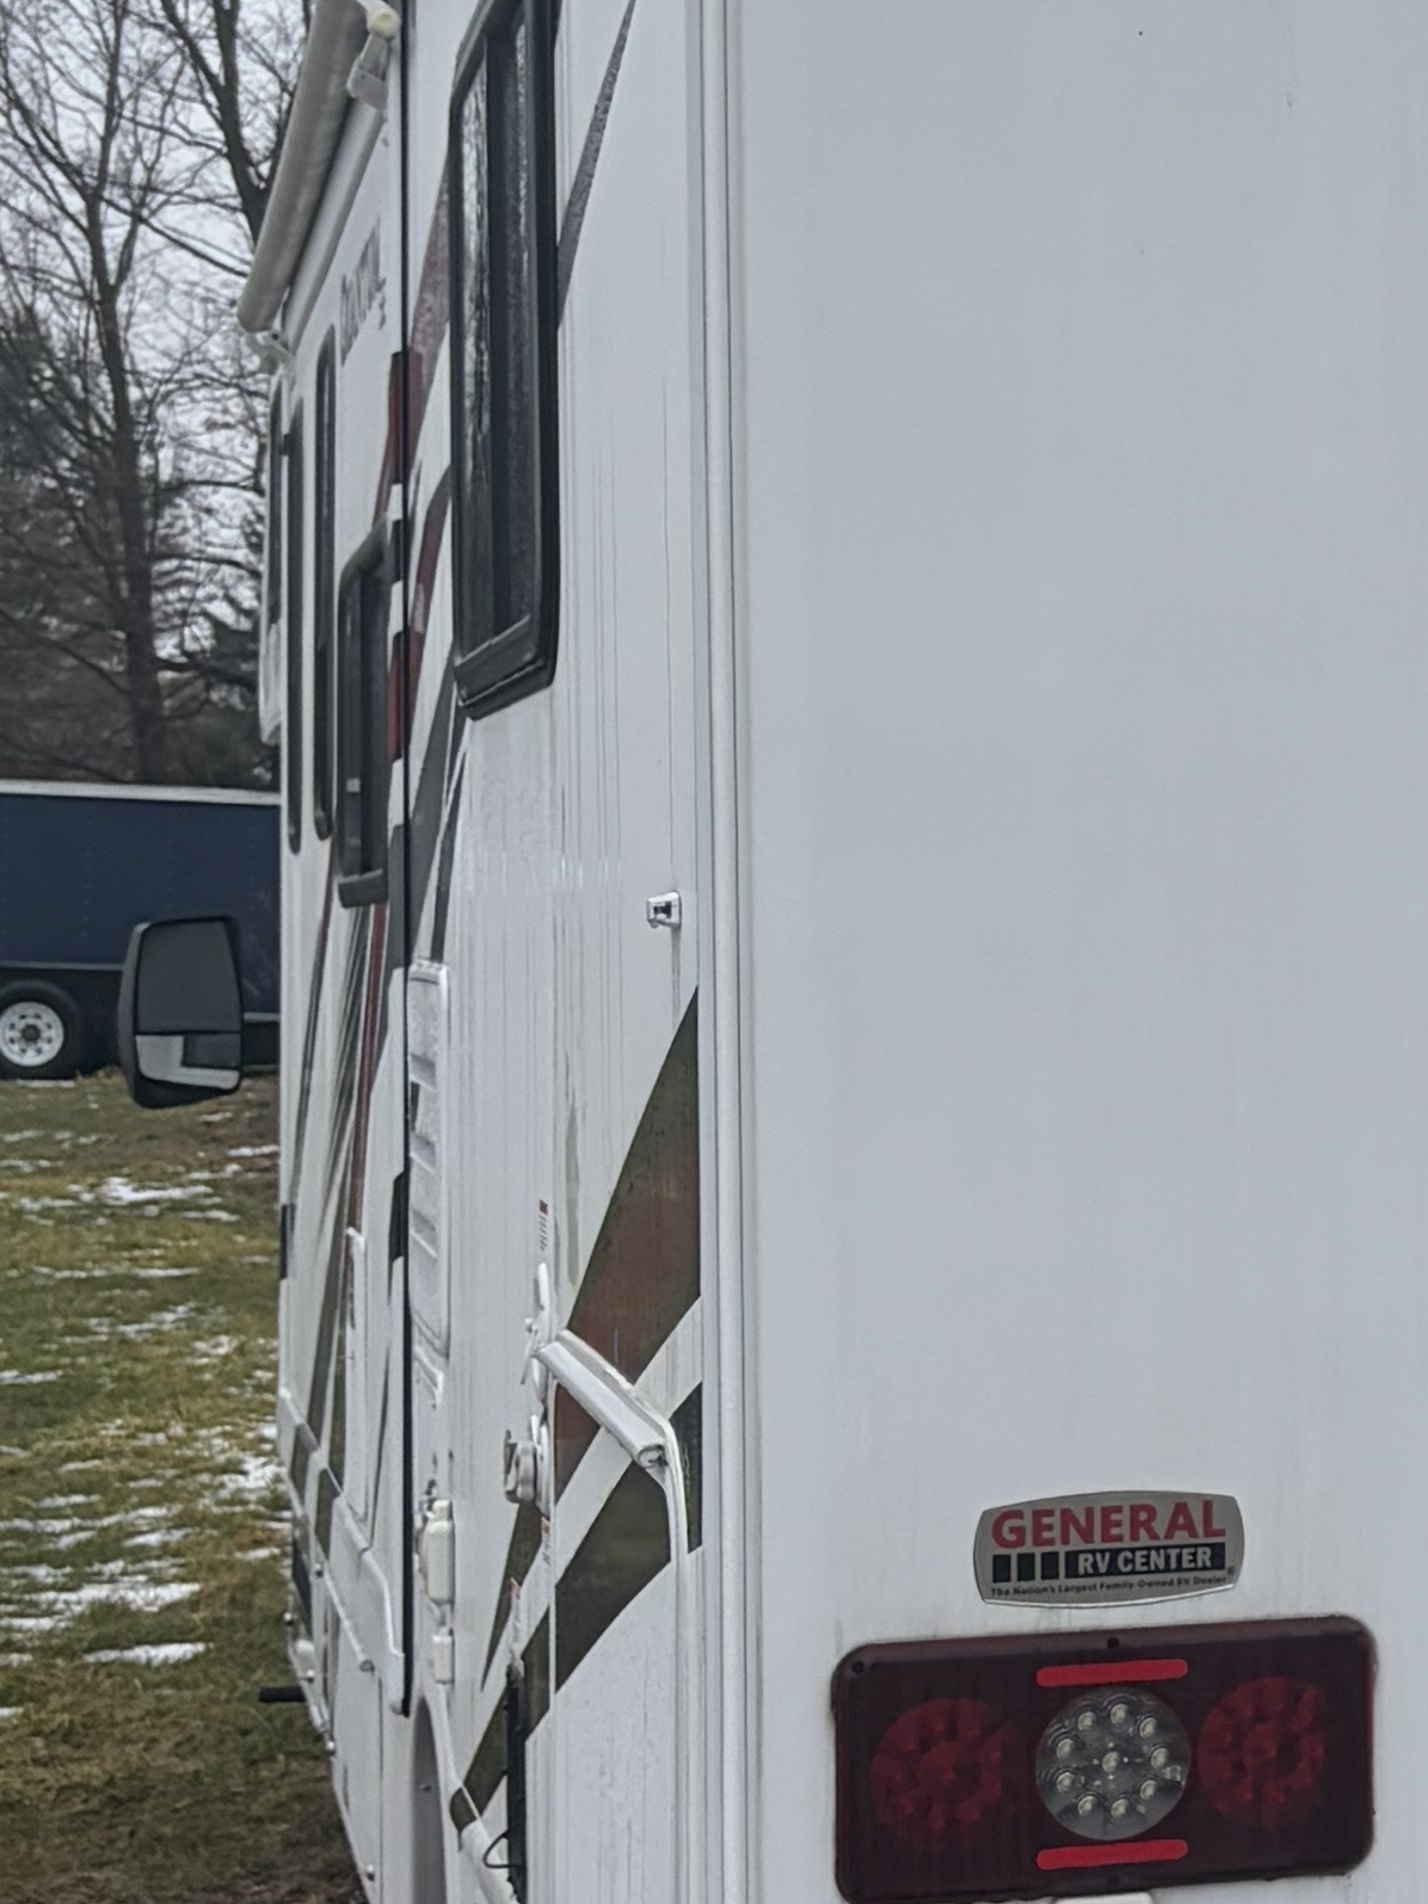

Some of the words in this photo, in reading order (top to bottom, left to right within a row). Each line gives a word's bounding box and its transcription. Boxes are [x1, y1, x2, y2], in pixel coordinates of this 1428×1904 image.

[991, 1500, 1226, 1549] GENERAL
[1078, 1551, 1111, 1575] RV
[1117, 1546, 1213, 1573] CENTER
[1058, 1581, 1098, 1594] Largest
